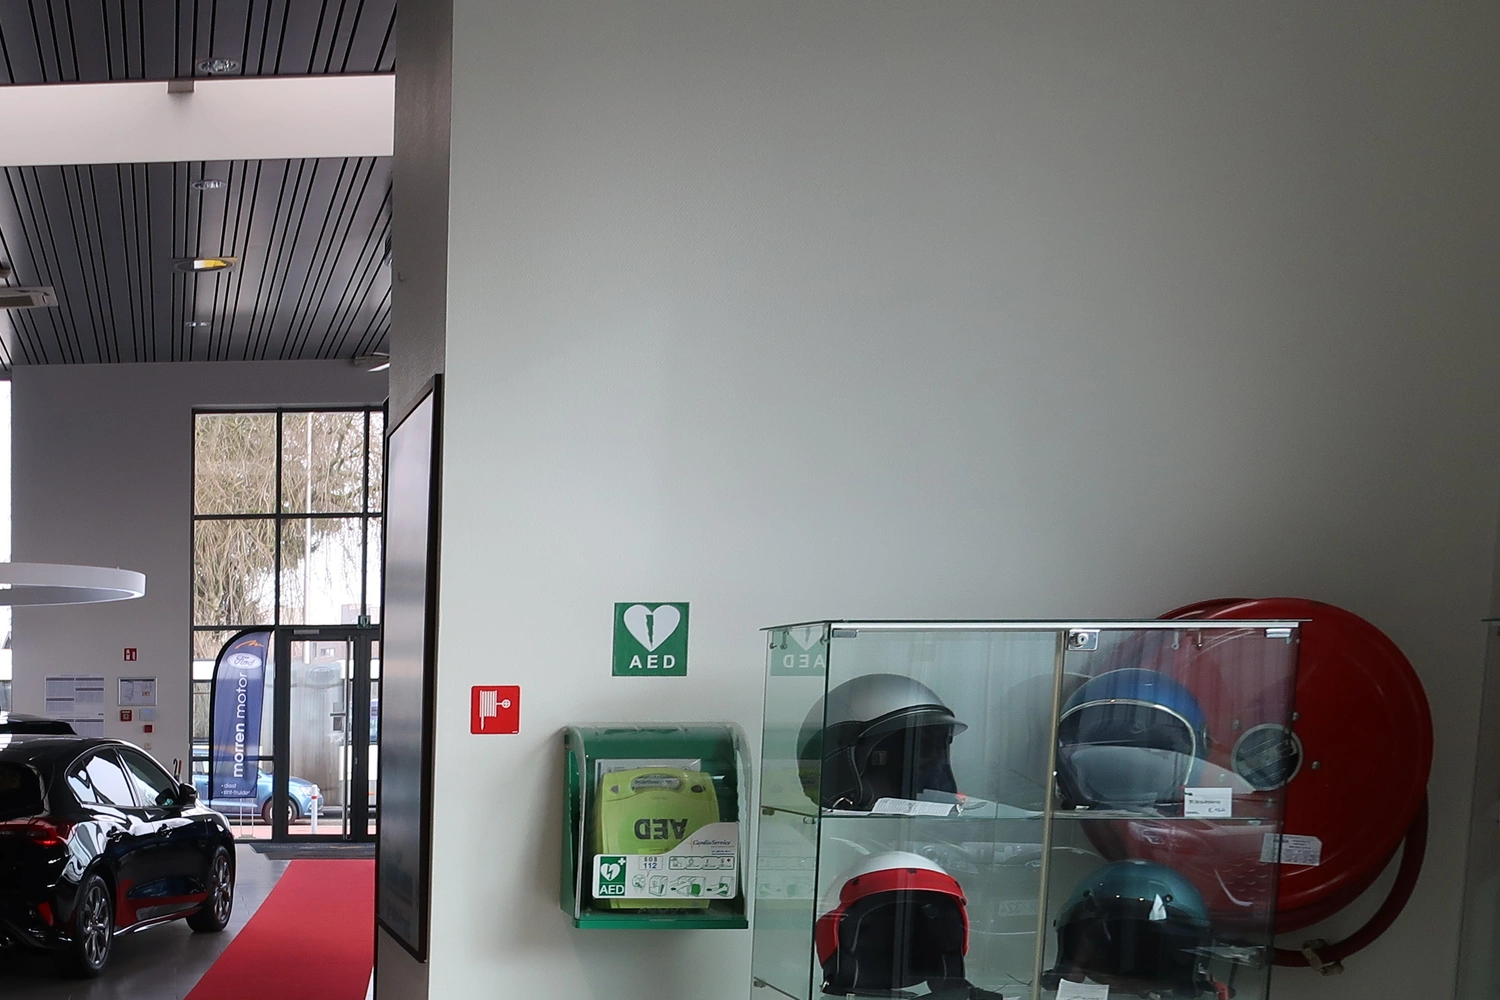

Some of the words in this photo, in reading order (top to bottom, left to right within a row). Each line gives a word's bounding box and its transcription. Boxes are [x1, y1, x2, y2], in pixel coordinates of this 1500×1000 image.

[629, 654, 675, 669] AED
[235, 672, 248, 718] motor
[233, 723, 245, 778] morren
[634, 818, 688, 840] AED
[599, 884, 625, 895] AED
